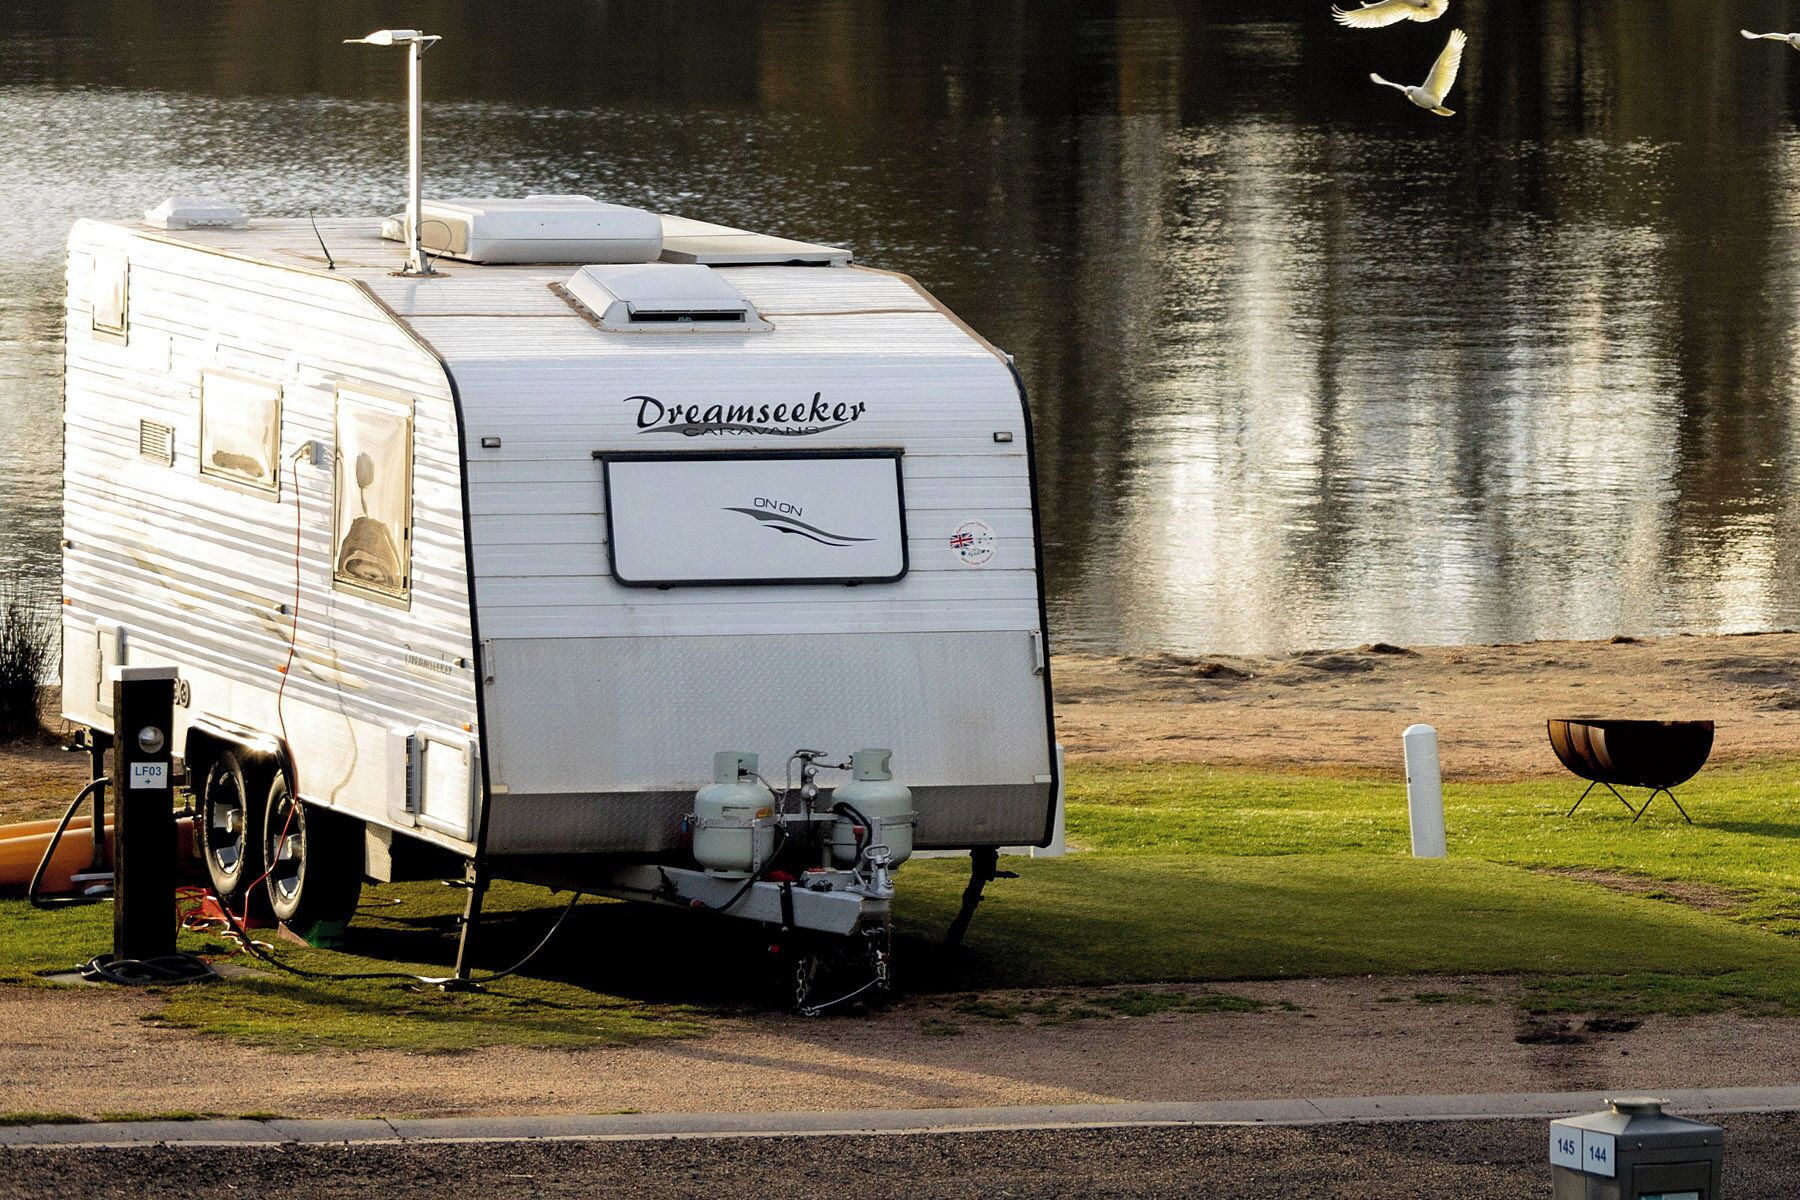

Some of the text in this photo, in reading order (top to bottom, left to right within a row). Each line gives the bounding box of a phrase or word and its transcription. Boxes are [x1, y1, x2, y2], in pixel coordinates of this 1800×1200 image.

[623, 391, 866, 428] Dreamseeker
[682, 425, 821, 437] CARAVANS
[754, 497, 803, 517] ON ON
[135, 766, 162, 776] LF03
[1557, 1138, 1607, 1163] 145 144
